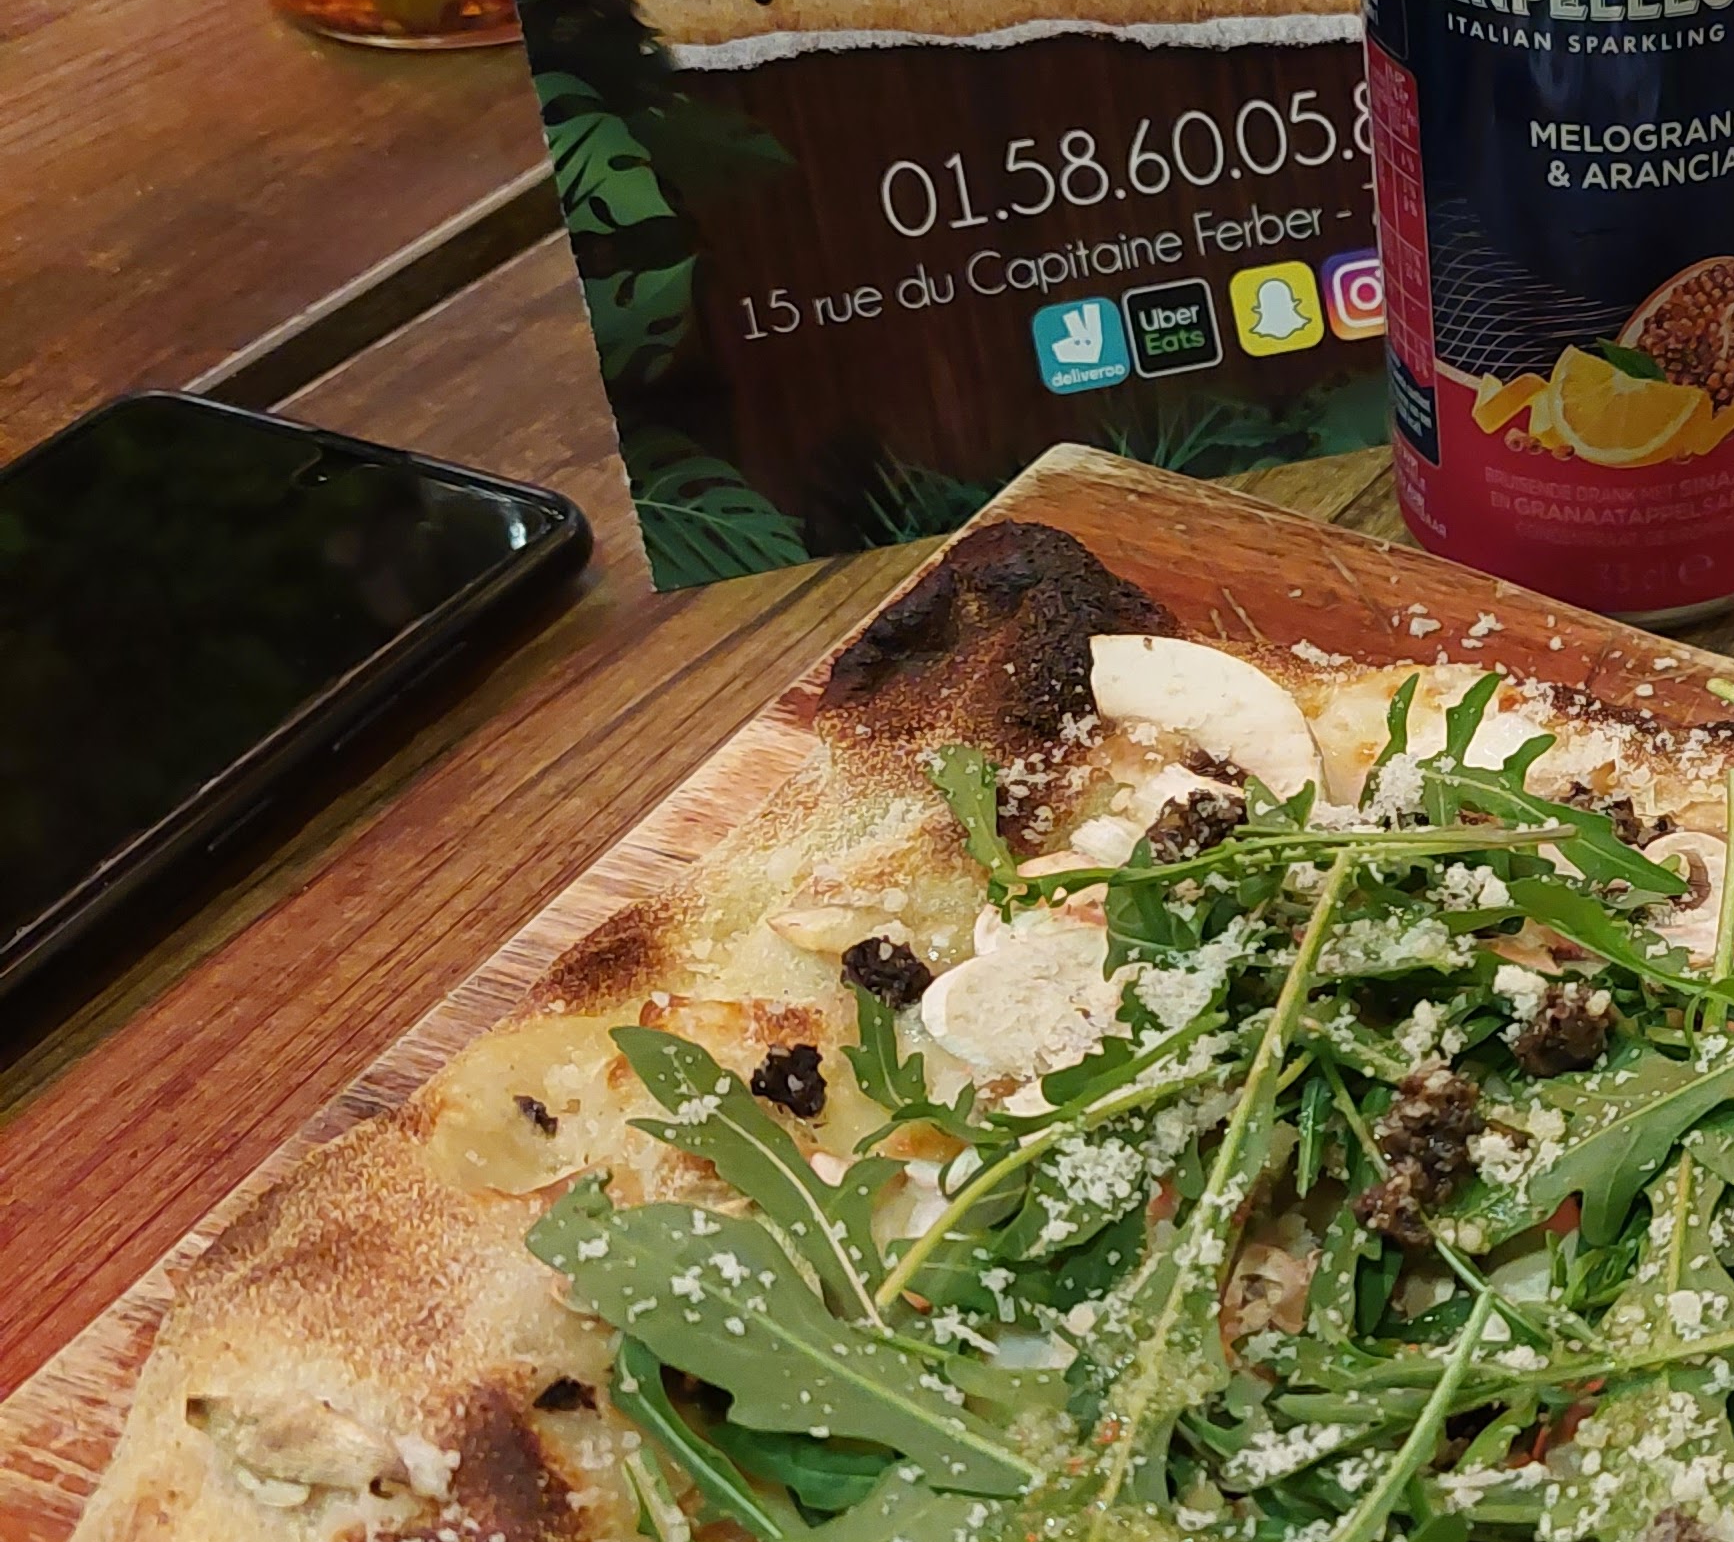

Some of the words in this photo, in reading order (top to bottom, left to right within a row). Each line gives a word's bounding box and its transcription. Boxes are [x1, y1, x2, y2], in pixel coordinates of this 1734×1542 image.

[1447, 12, 1552, 51] ITALIAN
[1567, 26, 1726, 55] SPARKLING
[1547, 161, 1570, 189] &
[740, 288, 800, 341] 15
[812, 288, 884, 326] rue
[898, 266, 955, 311] du
[966, 230, 1184, 297] Capitaine
[1193, 203, 1323, 257] Ferber
[1139, 302, 1200, 332] Uber
[1144, 326, 1207, 356] Eats
[1051, 361, 1126, 389] deliveroo
